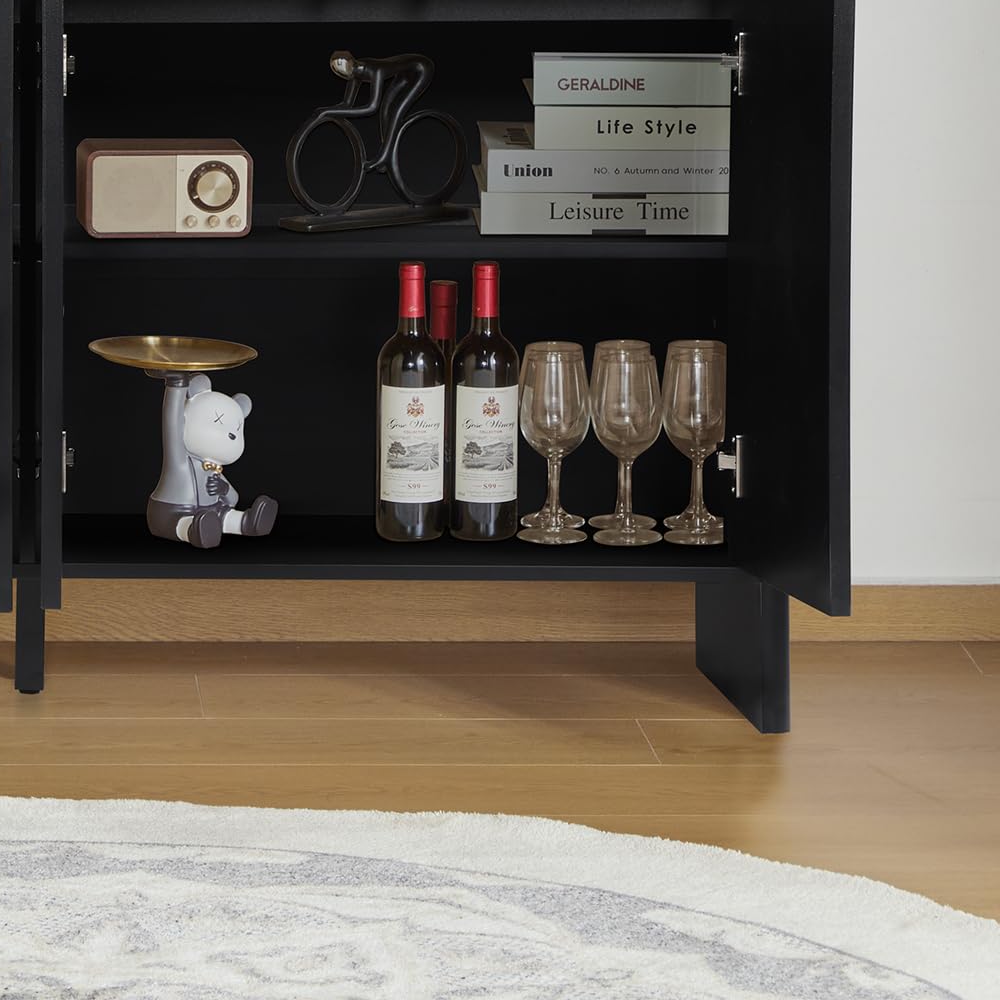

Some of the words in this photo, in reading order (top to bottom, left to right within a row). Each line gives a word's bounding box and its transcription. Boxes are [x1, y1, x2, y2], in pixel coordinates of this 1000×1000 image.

[558, 78, 646, 91] GERALDINE
[597, 119, 634, 134] Life
[644, 119, 697, 137] Style
[503, 164, 553, 177] Union
[593, 167, 610, 175] NO.
[614, 167, 620, 175] 6
[624, 167, 660, 175] Autumn
[661, 167, 679, 175] and
[683, 167, 714, 175] Winter
[550, 202, 624, 221] Leisure
[636, 202, 689, 221] Time
